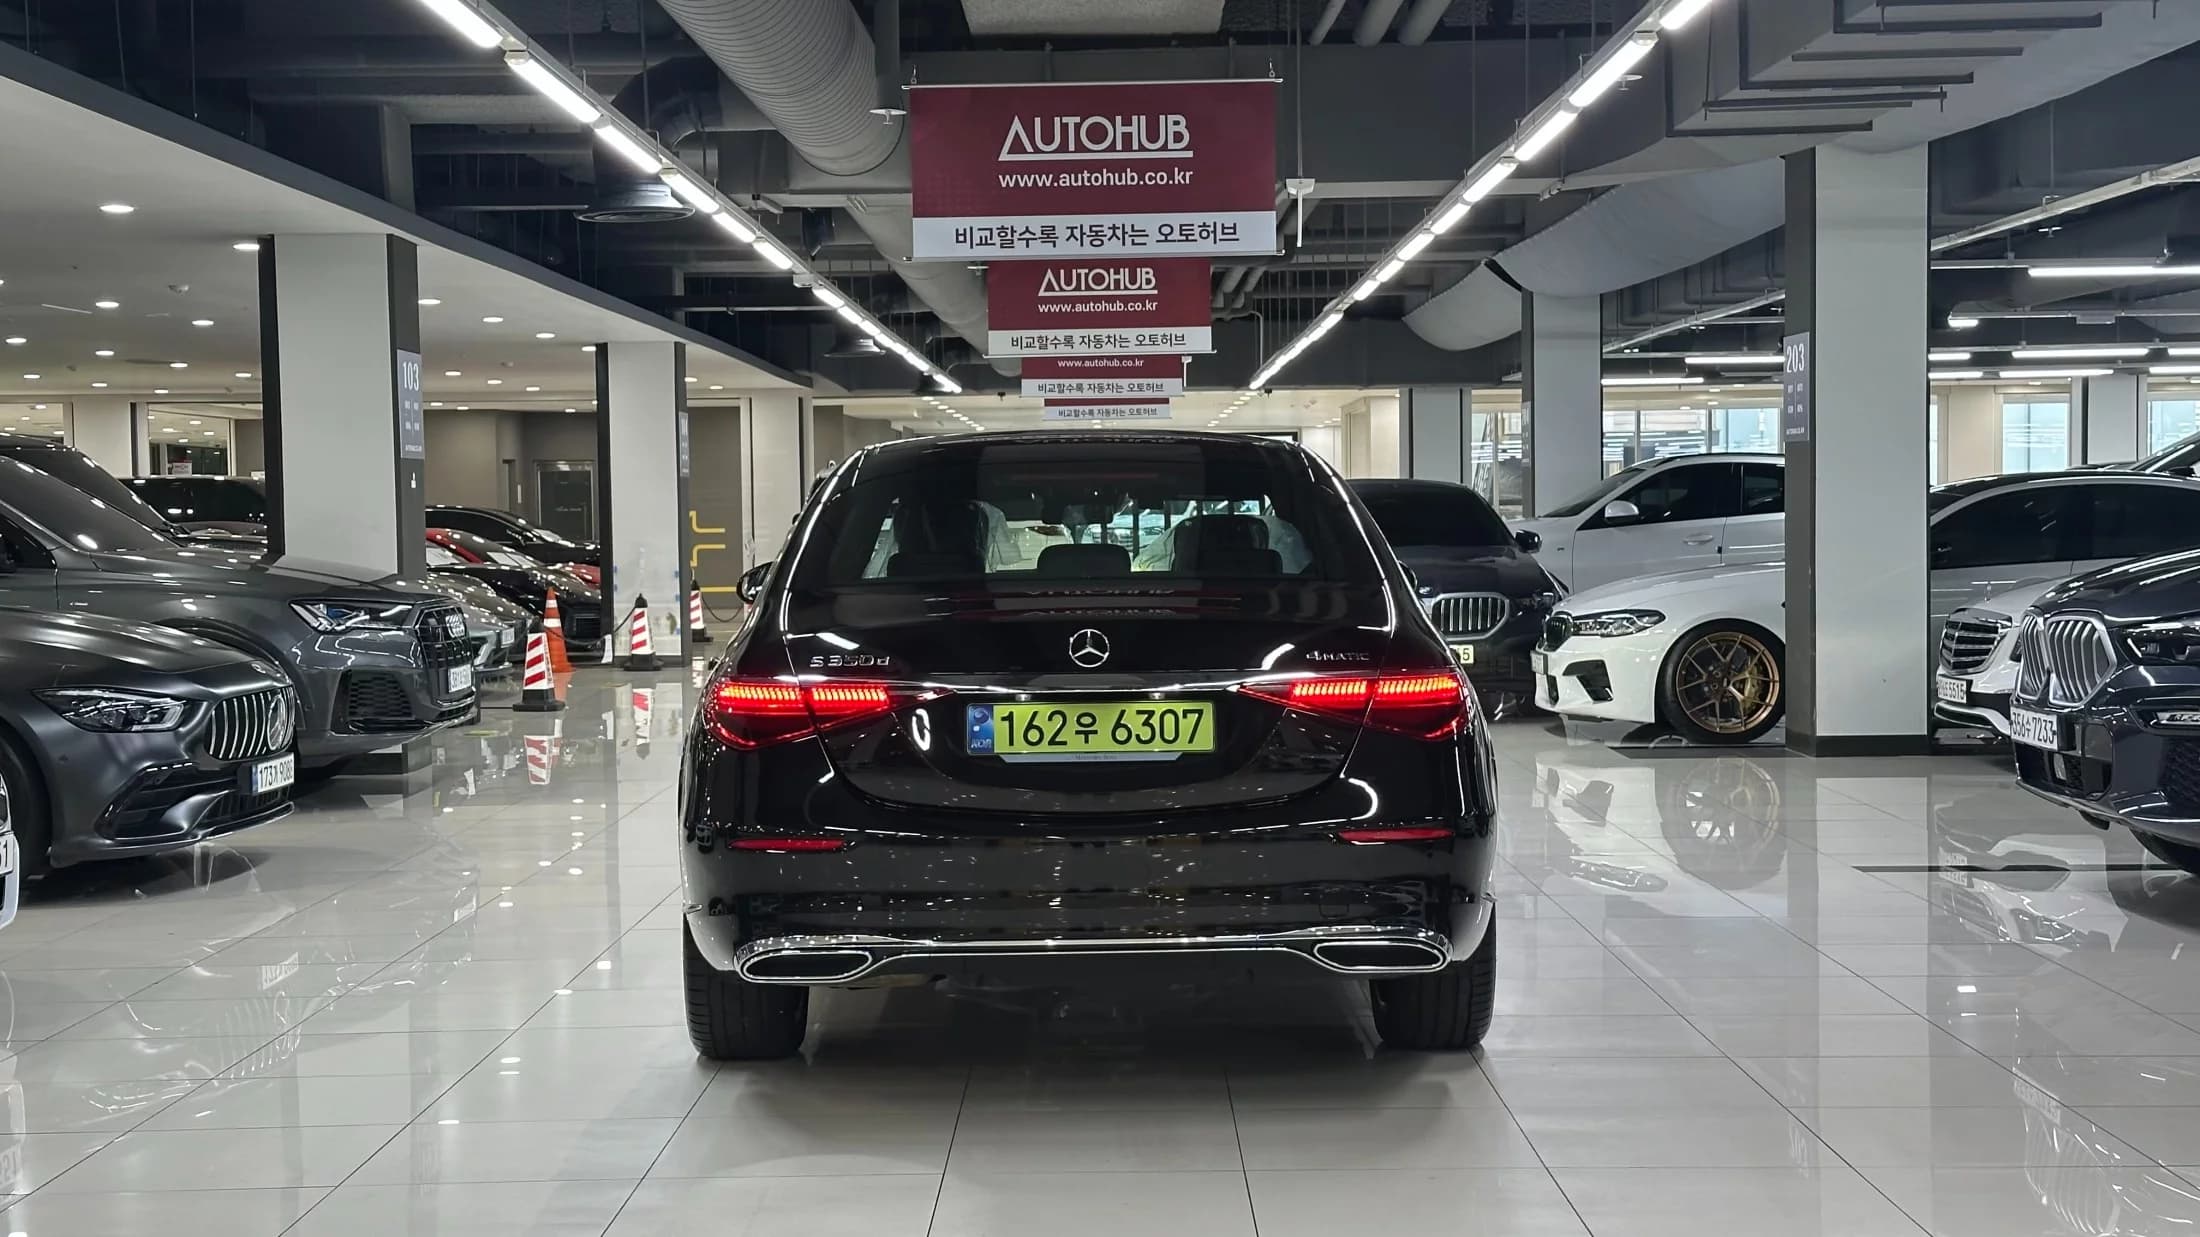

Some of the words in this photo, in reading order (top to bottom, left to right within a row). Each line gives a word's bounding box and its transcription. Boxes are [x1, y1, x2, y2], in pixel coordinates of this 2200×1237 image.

[998, 114, 1194, 161] AUTOHUB
[999, 167, 1193, 187] www.autohub.co.kr
[955, 225, 1059, 249] 비교할수록
[1065, 223, 1149, 247] 자동차는
[1156, 221, 1239, 244] 오토허브
[1038, 267, 1158, 296] AUTOHUB
[1038, 299, 1158, 313] www.autohub.co.kr
[1011, 335, 1075, 350] 비교할수록
[1079, 334, 1131, 349] 자동차는
[1135, 333, 1186, 347] 오토허브
[1057, 357, 1144, 368] www.autohub.co.kr
[1786, 343, 1805, 373] 203
[403, 361, 419, 391] 103
[1038, 382, 1084, 393] 비교할수록
[1087, 382, 1125, 393] 자동차는
[1127, 382, 1165, 392] 오토허브
[1306, 650, 1369, 661] 4MATIC
[1000, 710, 1099, 747] 162우
[1111, 708, 1204, 746] 6307
